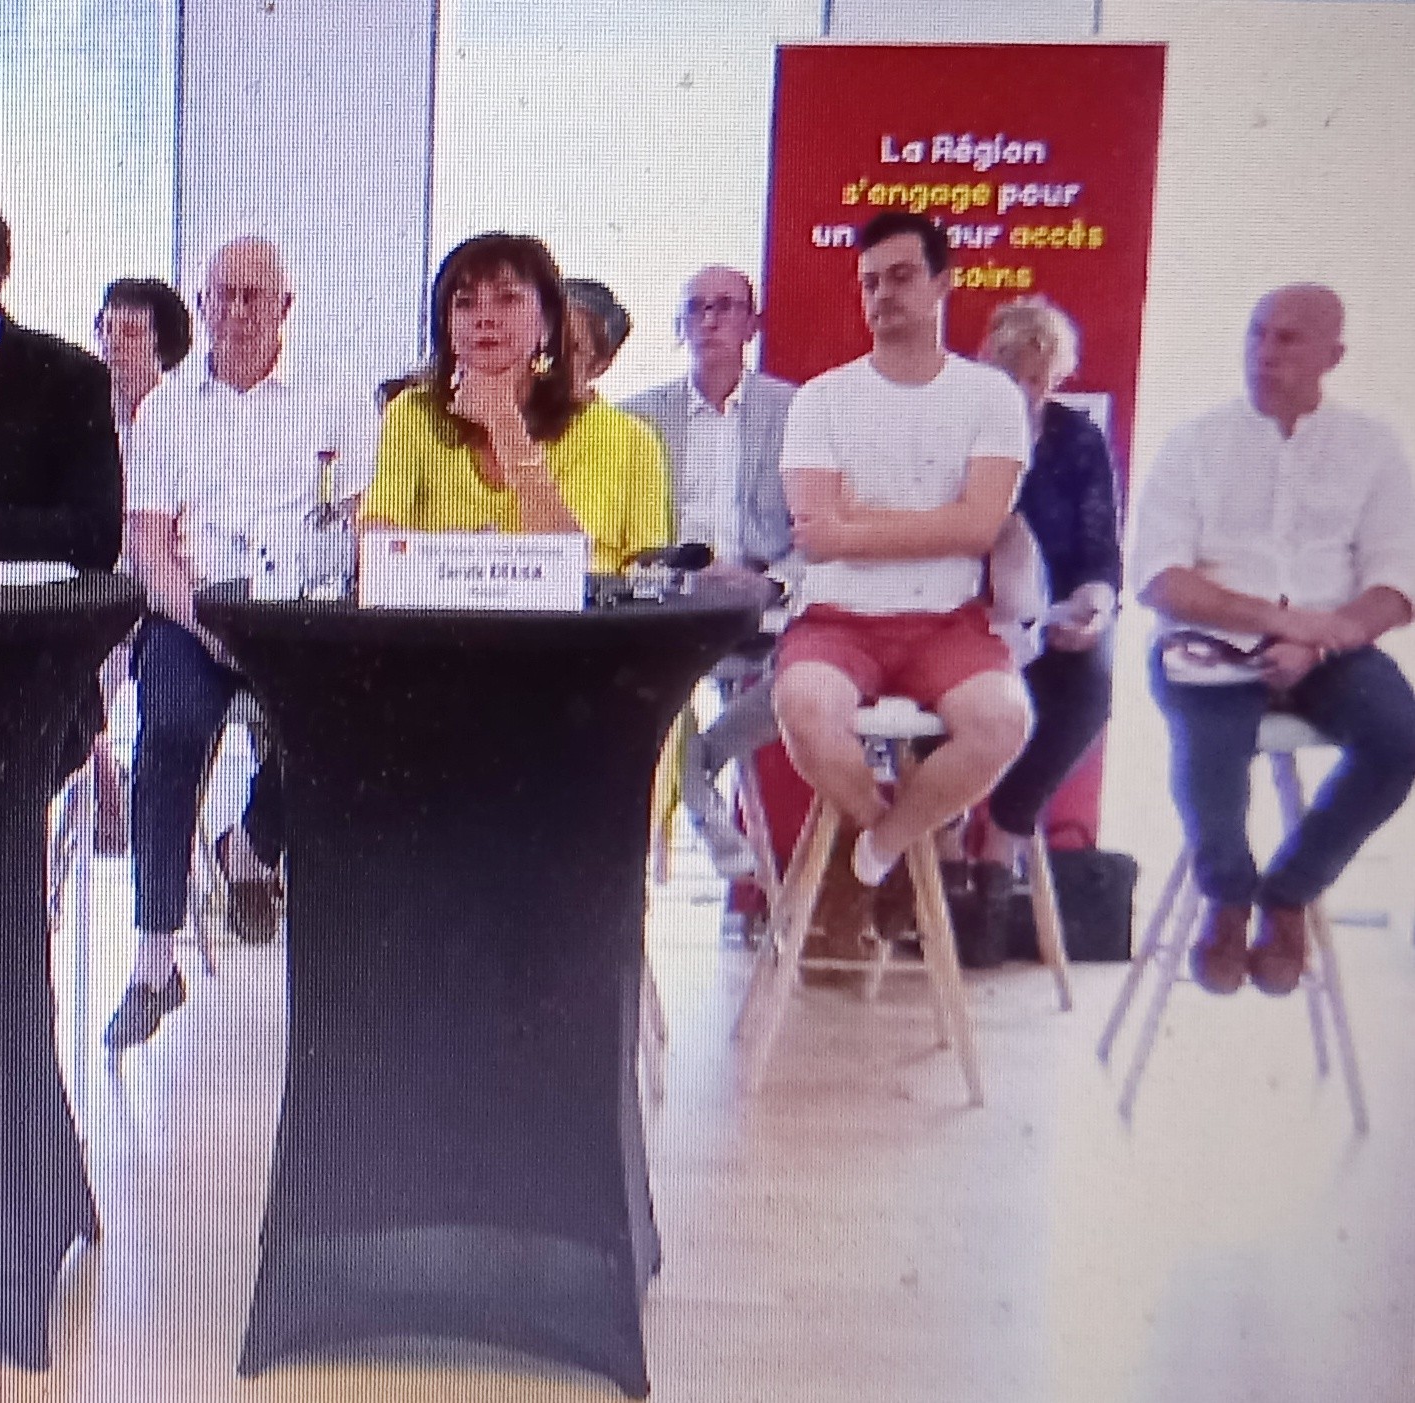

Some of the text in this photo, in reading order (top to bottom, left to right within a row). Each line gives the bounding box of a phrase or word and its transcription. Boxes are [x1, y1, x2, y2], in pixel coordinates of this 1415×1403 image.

[880, 132, 1048, 171] La Région
[842, 176, 1081, 214] s'engage pour
[812, 223, 856, 248] un
[1009, 217, 1105, 249] accès
